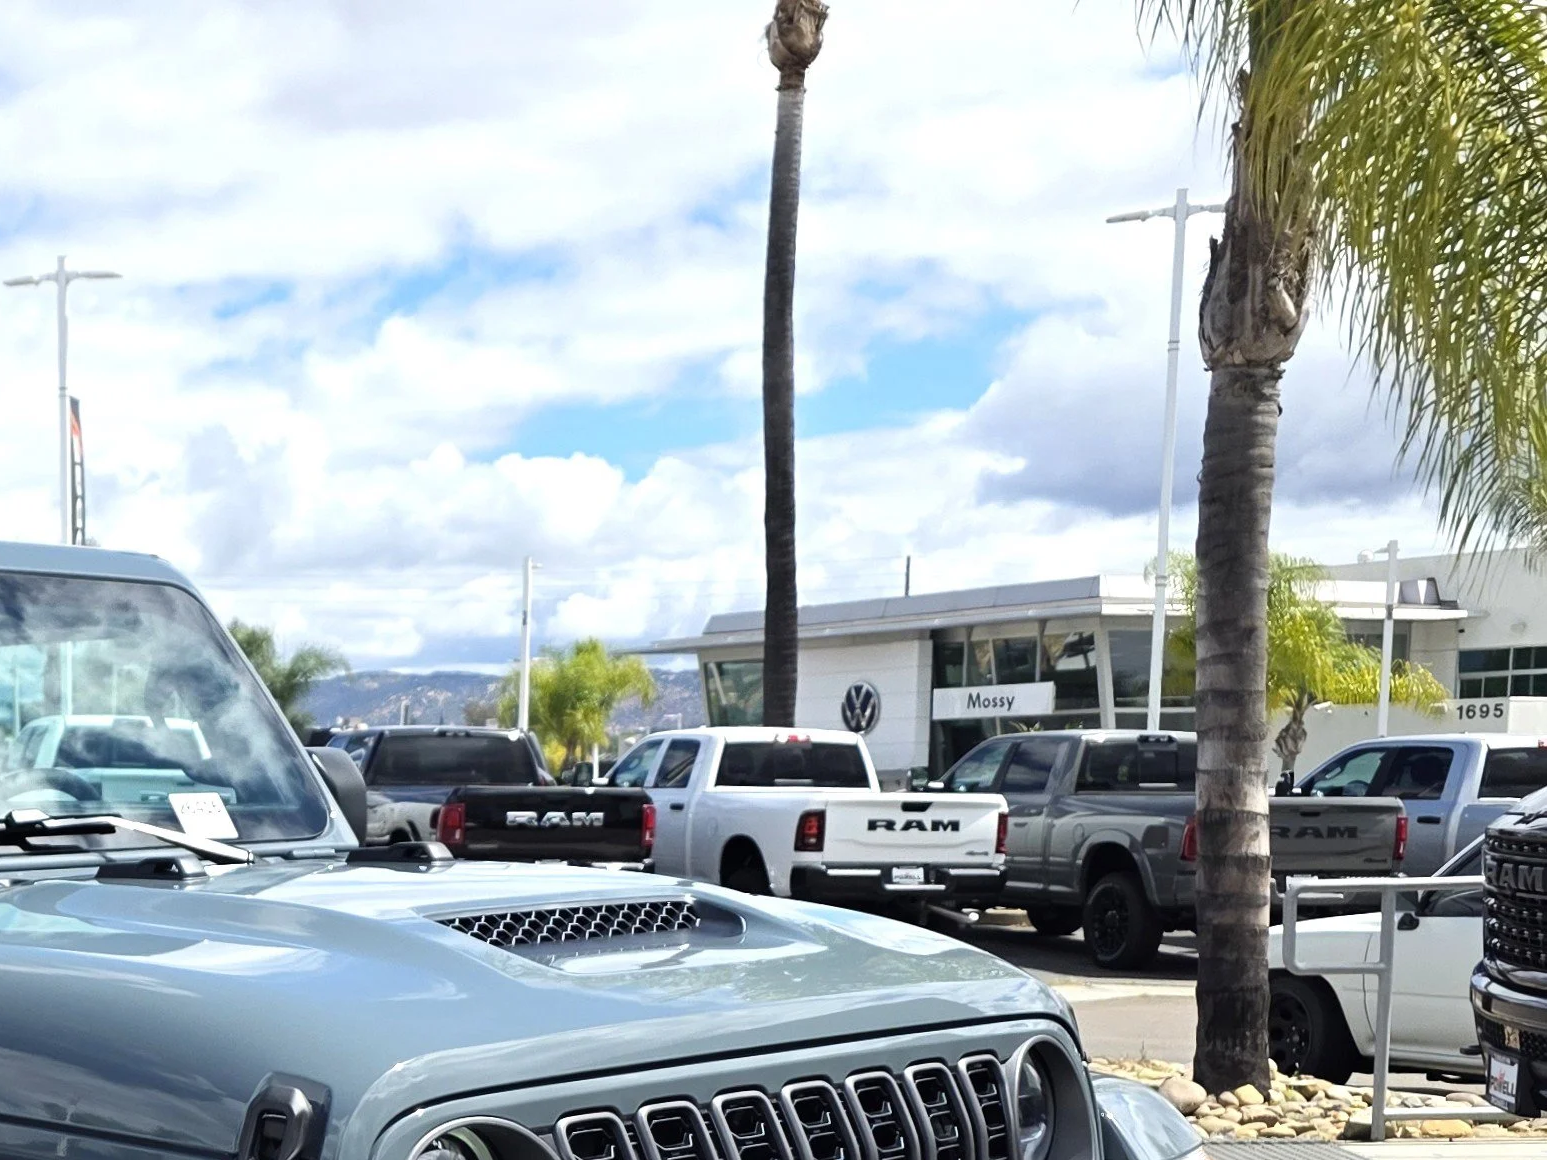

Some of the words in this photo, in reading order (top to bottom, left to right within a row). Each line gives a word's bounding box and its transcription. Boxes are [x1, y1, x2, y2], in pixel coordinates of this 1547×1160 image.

[966, 691, 1015, 711] Mossy
[1456, 702, 1504, 720] 1695
[505, 811, 605, 827] RAM
[867, 818, 960, 832] RAM
[1269, 825, 1358, 839] RAM
[1485, 859, 1545, 892] RAM
